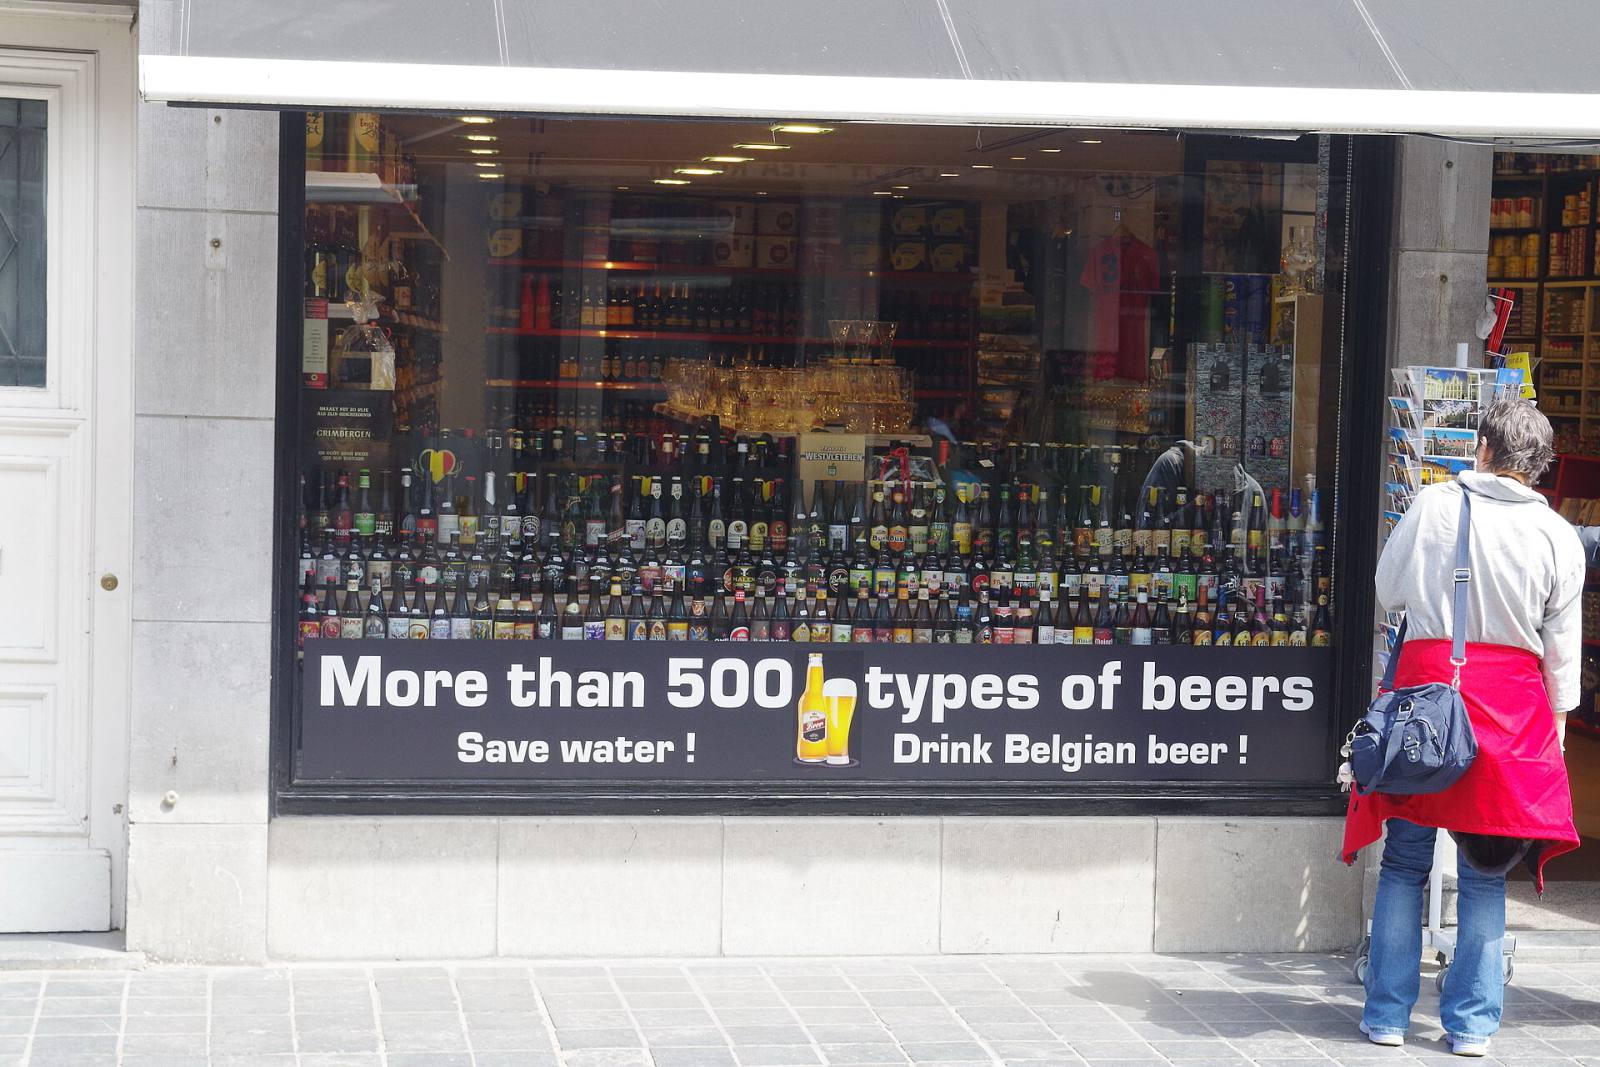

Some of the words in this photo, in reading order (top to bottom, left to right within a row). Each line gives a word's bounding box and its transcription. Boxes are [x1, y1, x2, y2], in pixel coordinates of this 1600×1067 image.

[316, 429, 371, 438] GRIMBERGEN
[805, 451, 864, 461] WESTVLETEREN
[320, 654, 488, 708] More
[506, 656, 645, 708] than
[666, 657, 793, 709] 500
[864, 666, 1040, 724] types
[1061, 660, 1122, 710] of
[1142, 661, 1314, 711] beers
[457, 731, 550, 763] Save
[559, 736, 675, 764] water
[893, 733, 993, 764] Drink
[1004, 733, 1136, 773] Belgian
[1147, 734, 1228, 765] beer
